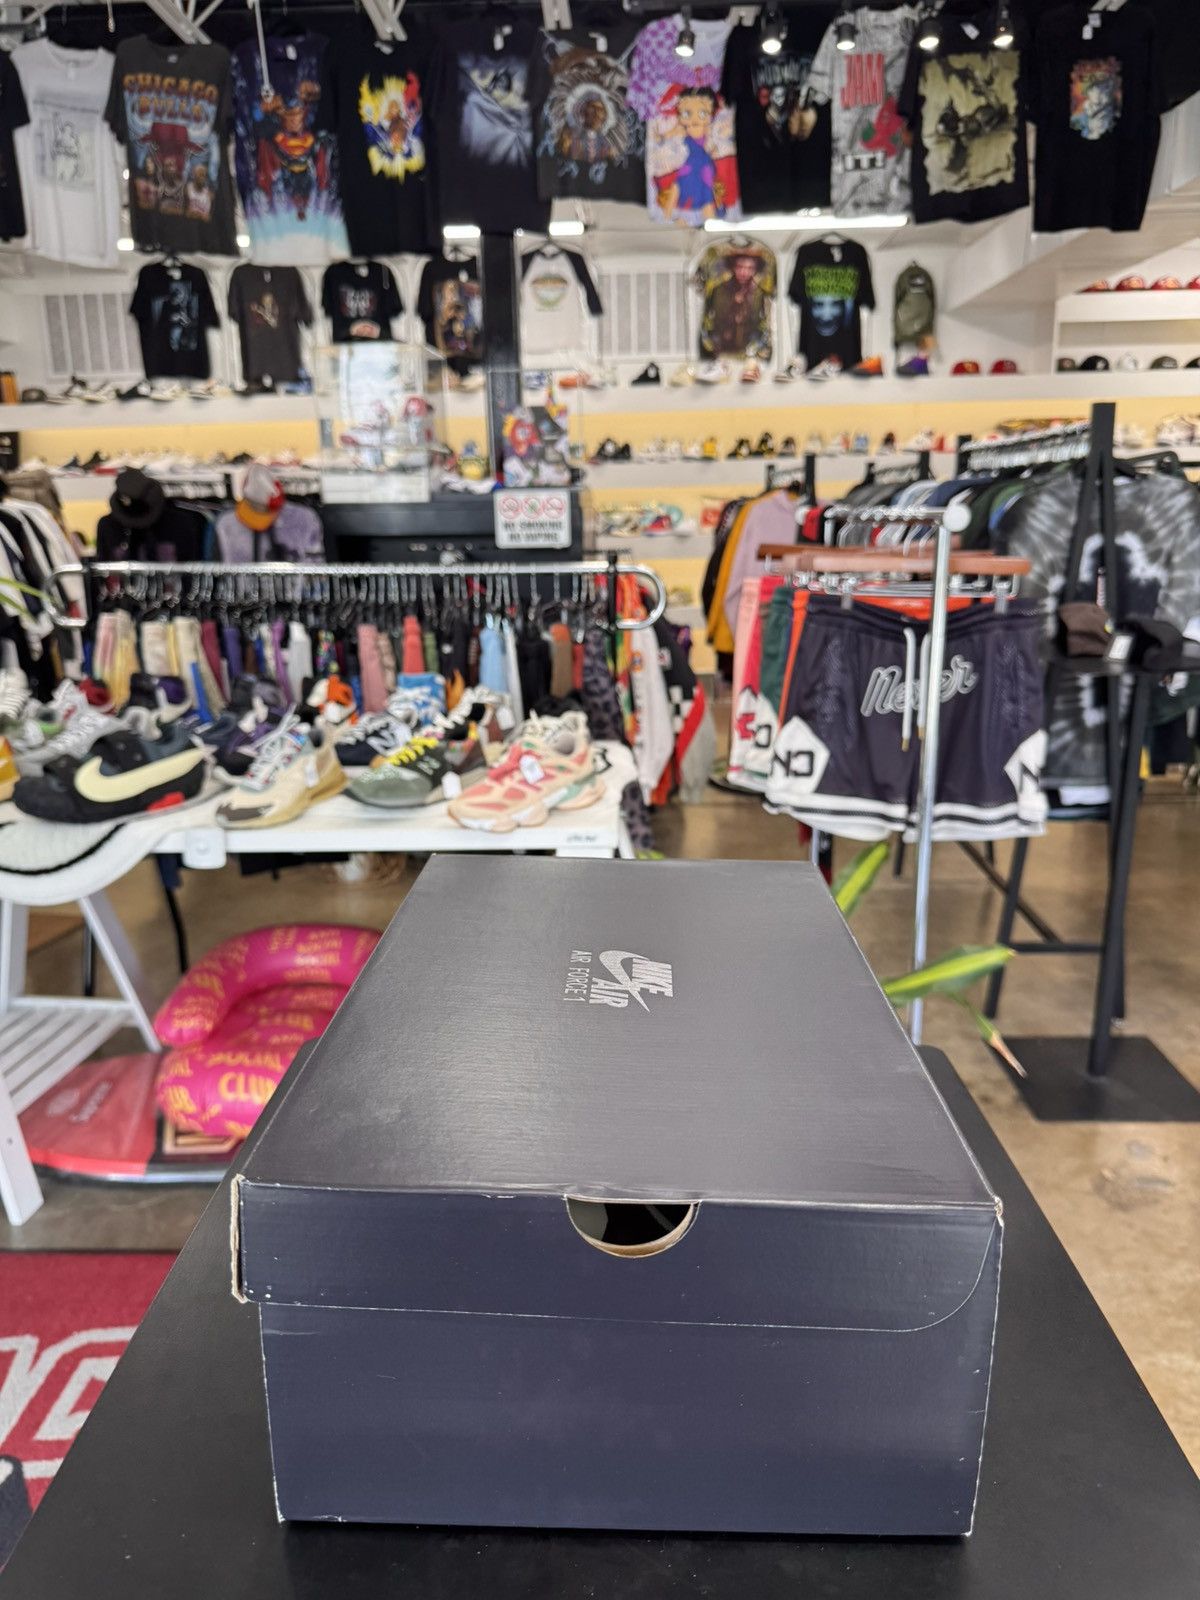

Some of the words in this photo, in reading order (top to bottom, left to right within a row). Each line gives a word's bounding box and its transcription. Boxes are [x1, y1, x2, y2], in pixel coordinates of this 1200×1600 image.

[123, 72, 218, 102] CHICAGO
[840, 53, 885, 110] JAM
[861, 654, 979, 717] Neer
[570, 949, 592, 963] AIR
[564, 967, 590, 994] FORCE
[589, 977, 629, 1008] AIR
[632, 958, 673, 997] NIKE
